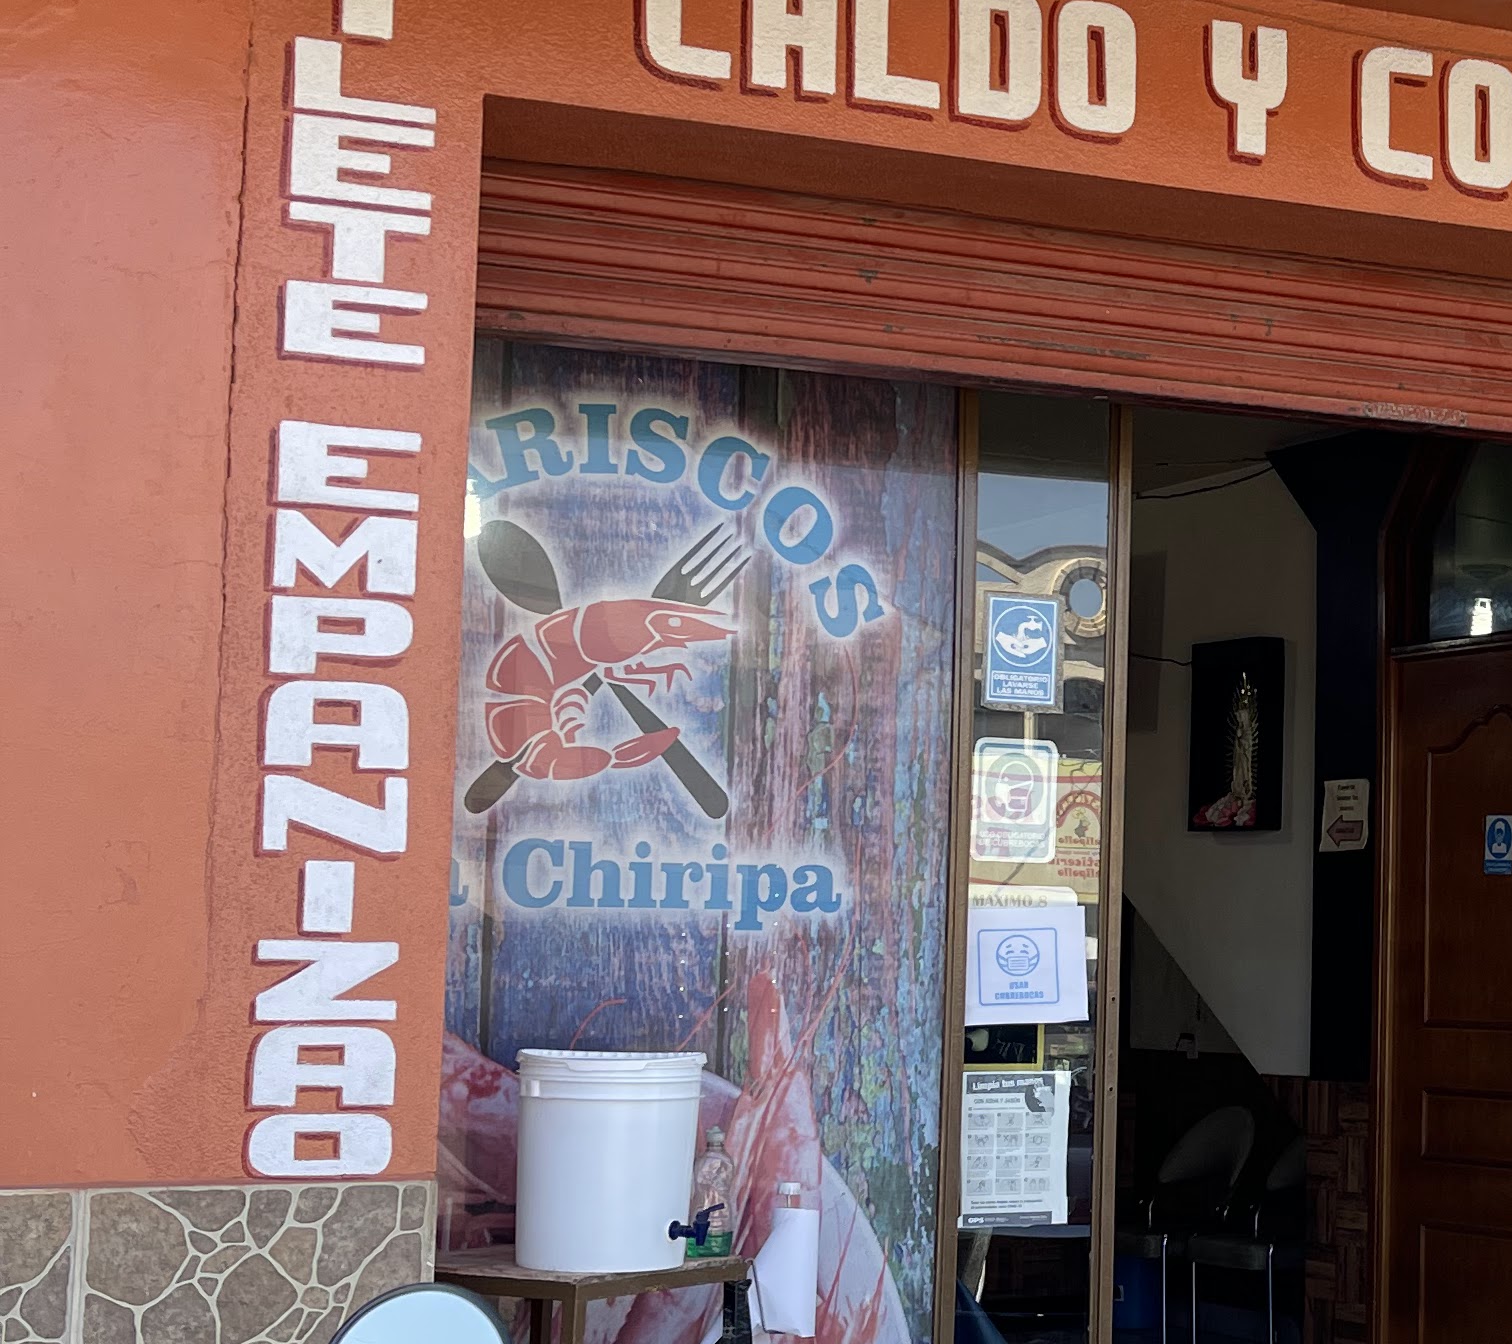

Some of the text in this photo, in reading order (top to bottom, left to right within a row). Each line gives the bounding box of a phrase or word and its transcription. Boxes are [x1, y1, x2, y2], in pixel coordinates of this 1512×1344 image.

[1205, 19, 1289, 162] Y
[993, 674, 1048, 683] OBLIGATORIO
[1003, 681, 1038, 689] LAVARSE
[1014, 688, 1044, 696] MANOS
[246, 420, 423, 1178] EMPANIZAO
[502, 839, 842, 931] Chiripa
